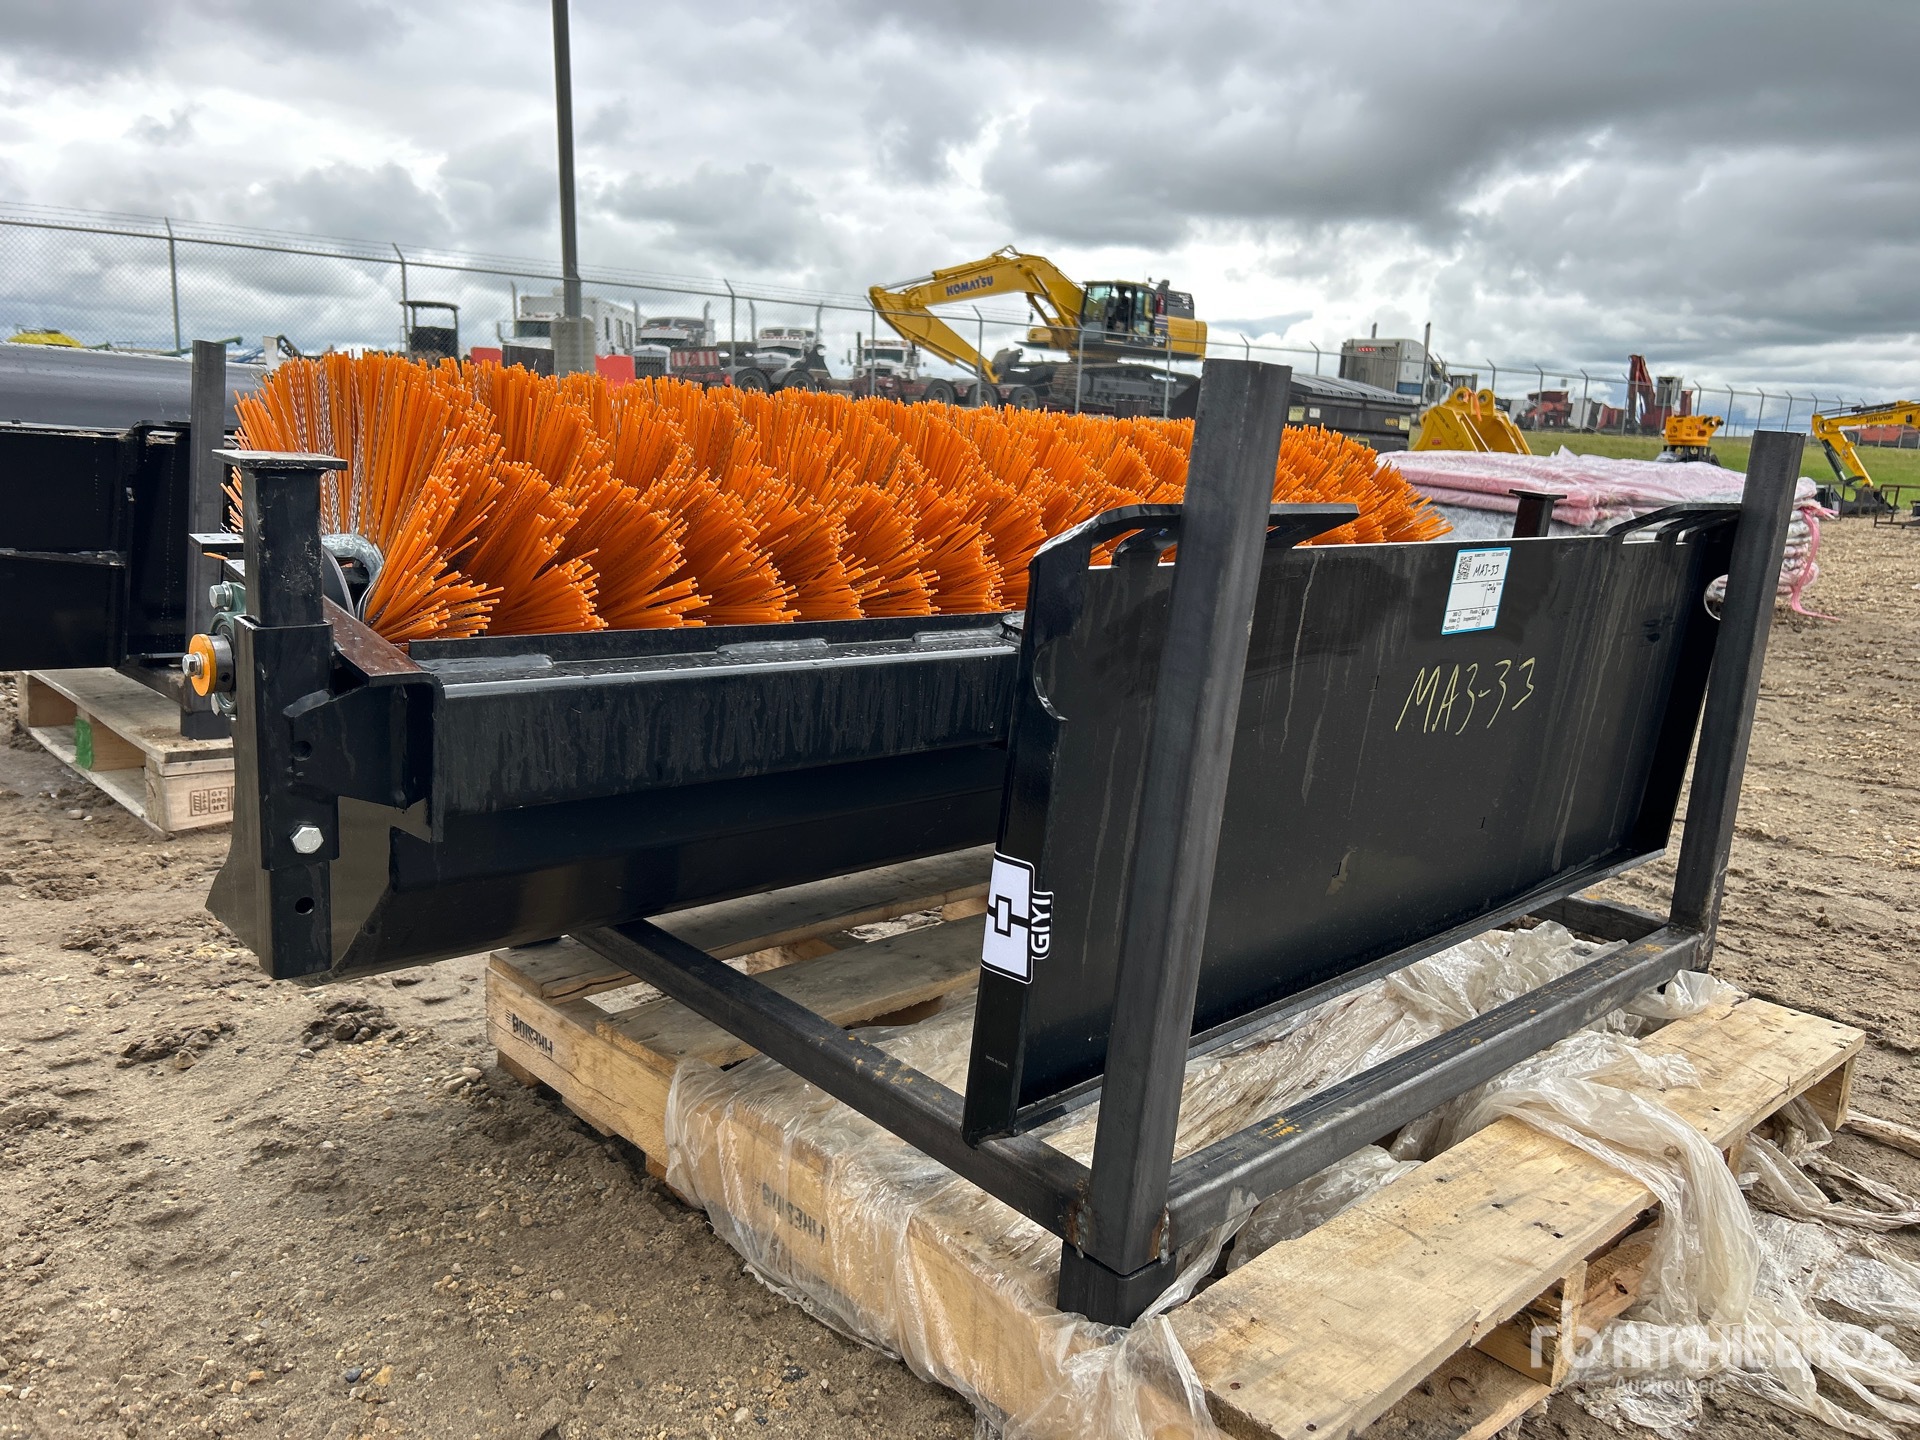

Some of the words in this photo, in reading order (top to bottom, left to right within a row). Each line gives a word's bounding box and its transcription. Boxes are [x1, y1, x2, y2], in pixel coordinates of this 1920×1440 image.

[945, 275, 994, 297] KOMATSU
[1395, 657, 1536, 736] MA3-33
[1030, 897, 1051, 955] GIYI
